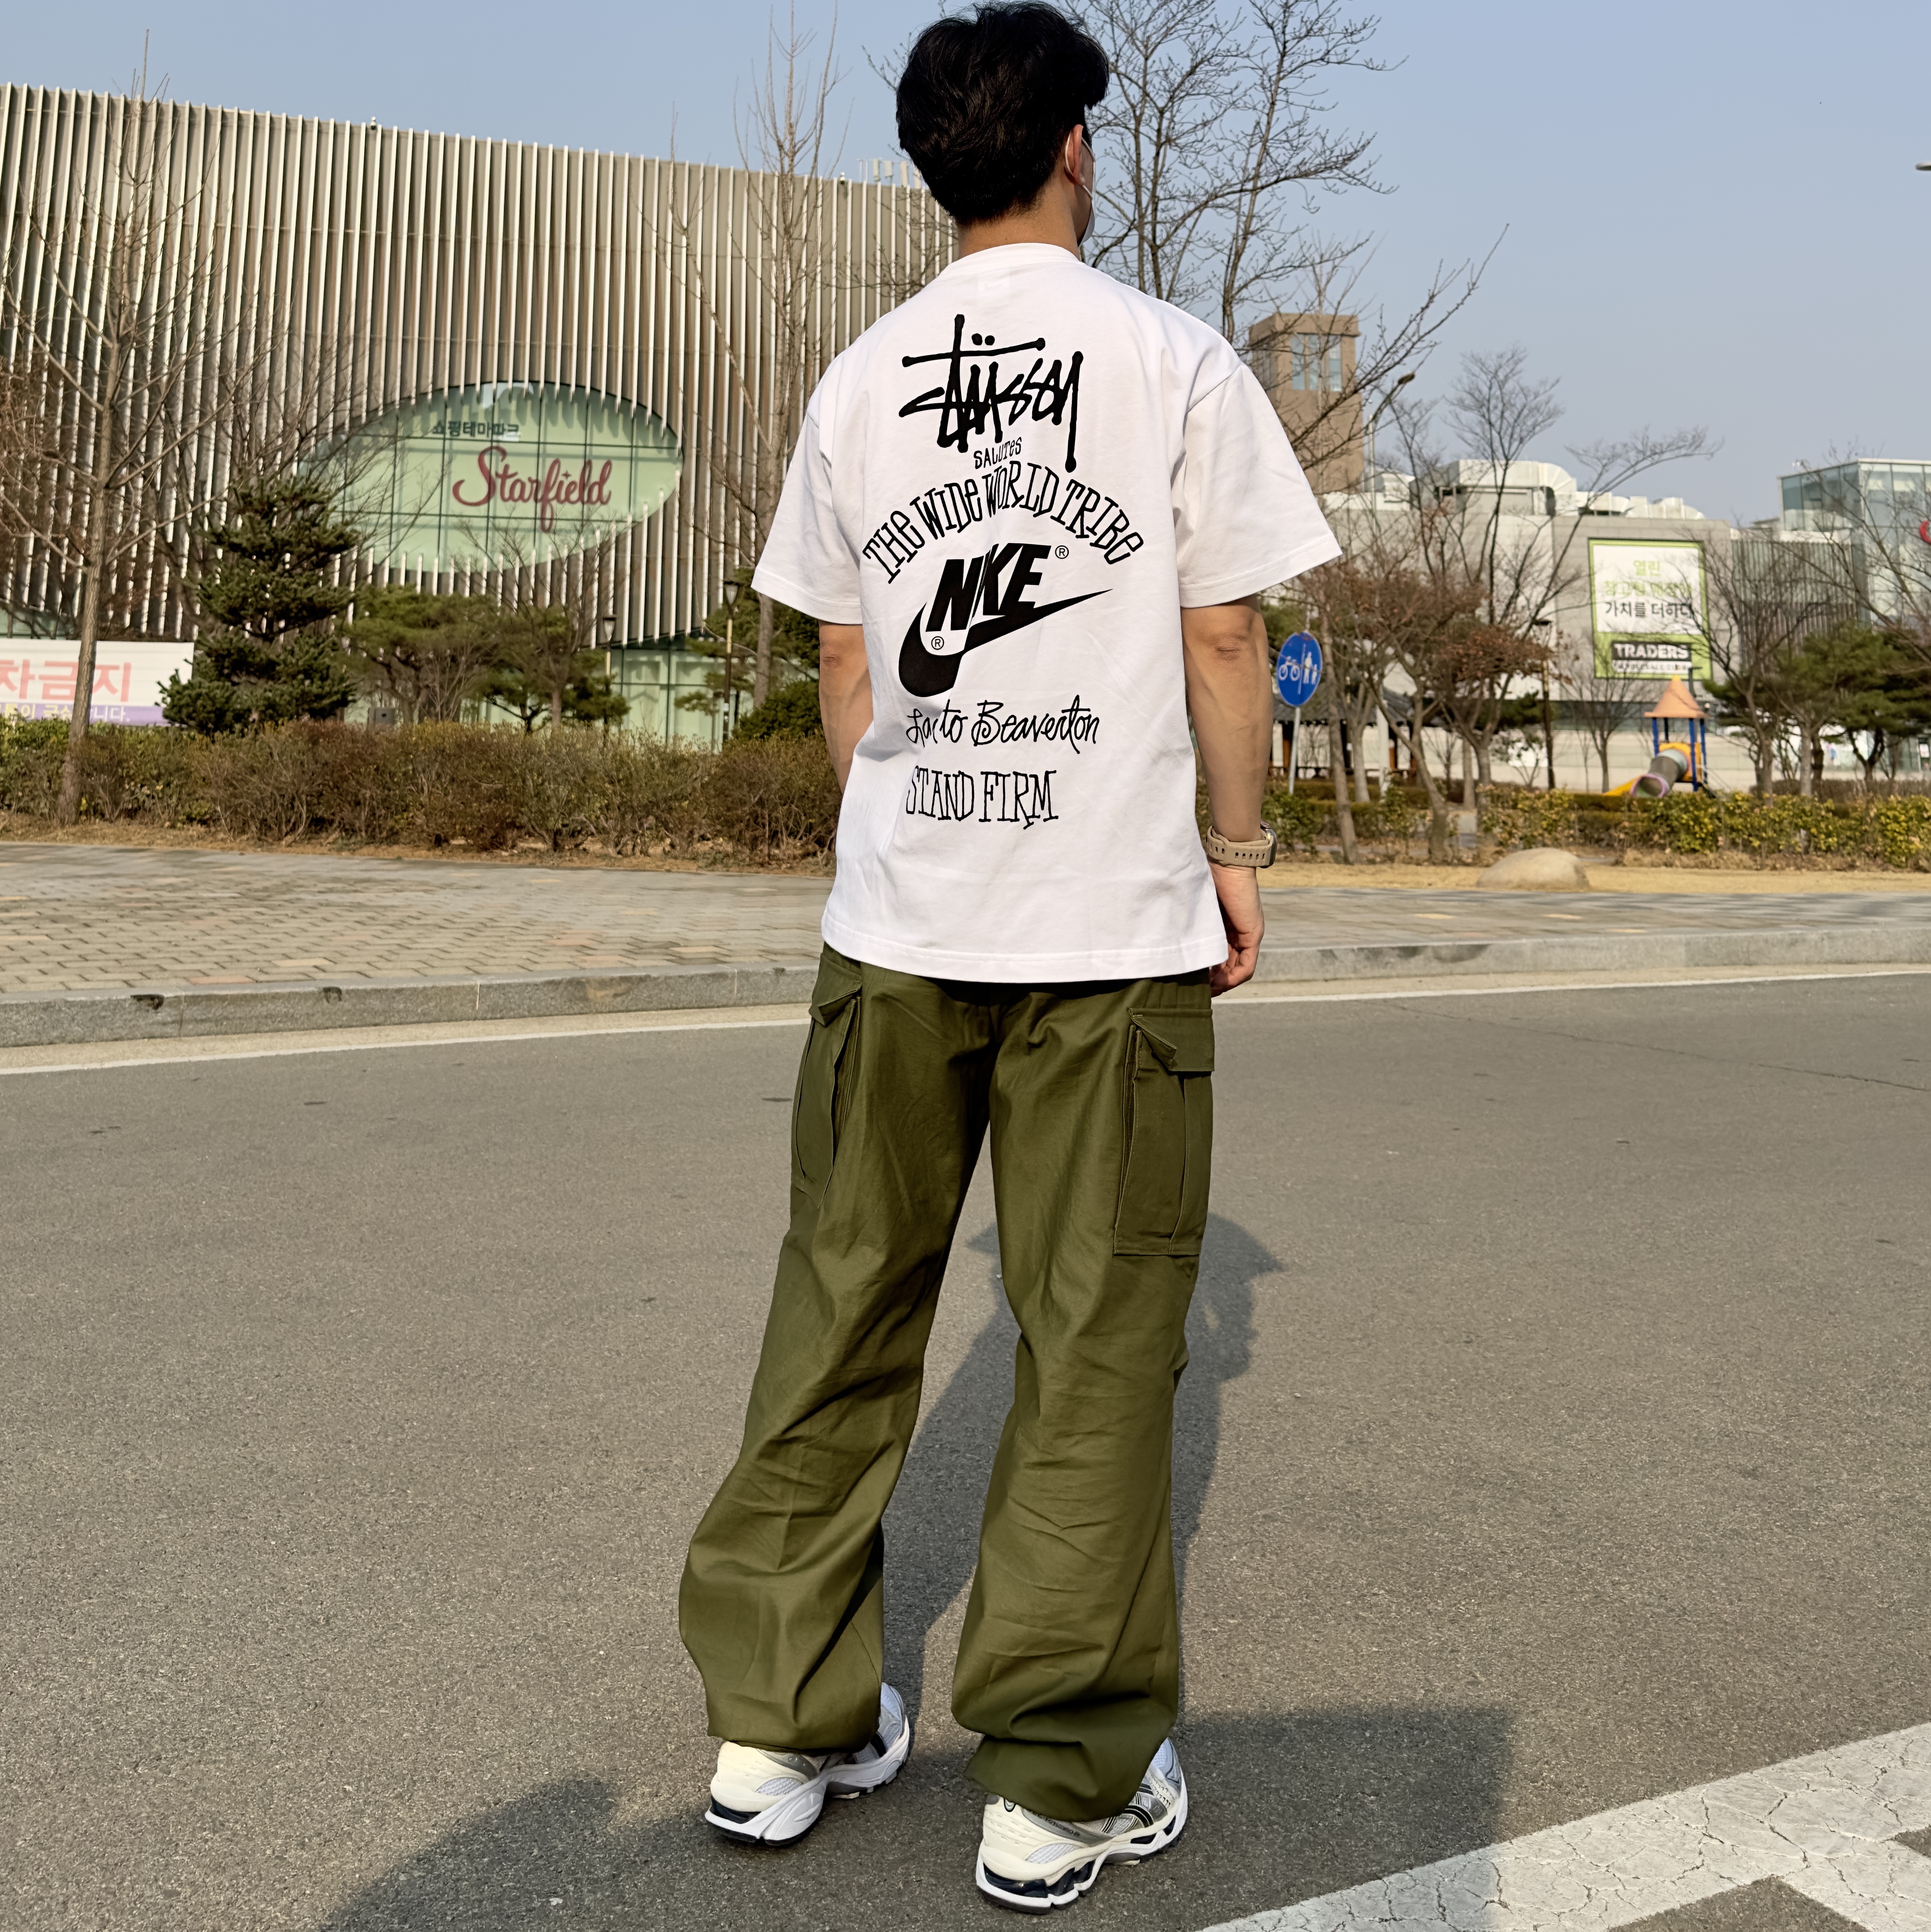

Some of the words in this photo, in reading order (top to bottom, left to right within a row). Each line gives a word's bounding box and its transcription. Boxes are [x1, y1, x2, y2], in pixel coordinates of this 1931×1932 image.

[432, 420, 519, 438] 쇼핑테마파크
[453, 446, 612, 533] Starfield
[981, 461, 1059, 517] WORLD
[1605, 601, 1646, 618] 가치를
[1614, 643, 1689, 659] TRADERS
[939, 699, 968, 743] to
[971, 695, 1100, 754] Beaverton
[906, 766, 974, 821] STAND
[979, 770, 1058, 829] FIRM
